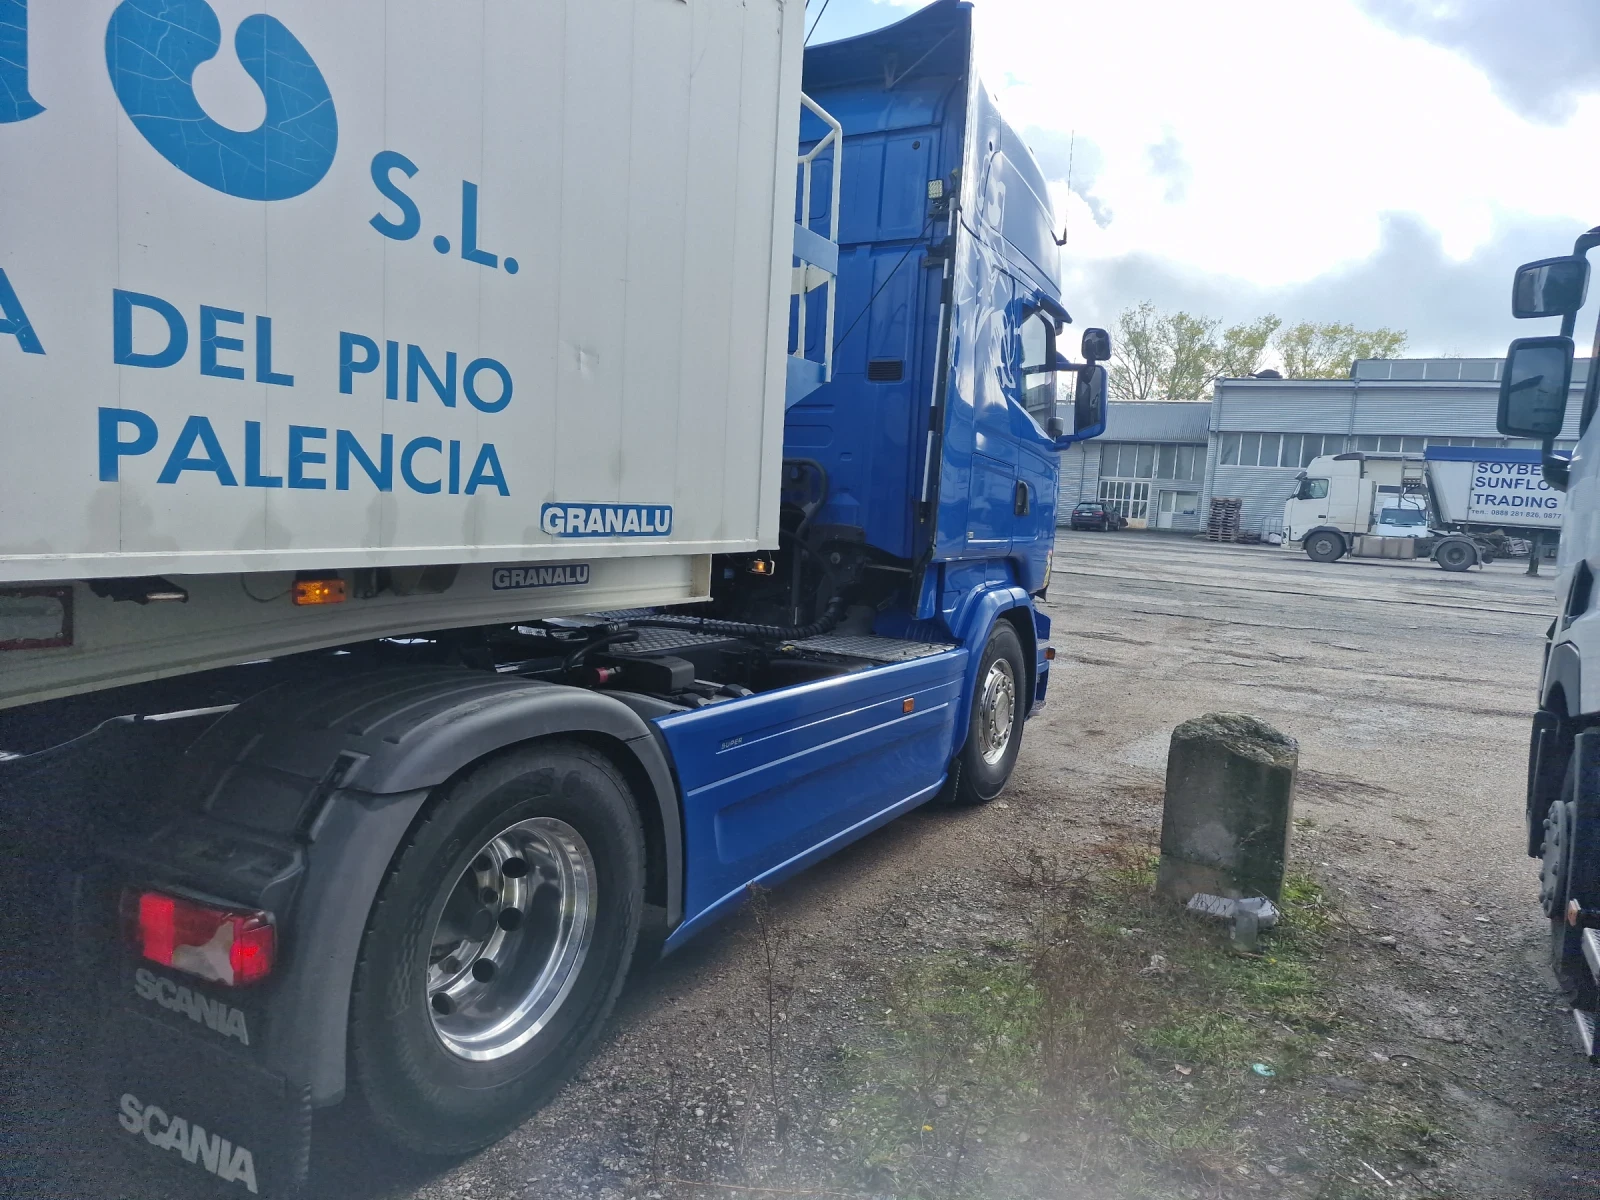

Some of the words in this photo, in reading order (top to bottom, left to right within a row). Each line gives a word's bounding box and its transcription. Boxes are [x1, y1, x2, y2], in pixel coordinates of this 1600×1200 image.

[370, 151, 519, 274] S.L.
[113, 290, 294, 386] DEL
[340, 332, 513, 413] PINO
[98, 408, 510, 496] PALENCIA
[1474, 476, 1557, 491] SUNFLO
[543, 506, 670, 535] GRANALU
[1473, 494, 1557, 509] TRADING
[494, 565, 588, 588] GRANALU
[135, 967, 249, 1046] SCANIA
[118, 1093, 258, 1194] SCANIA
